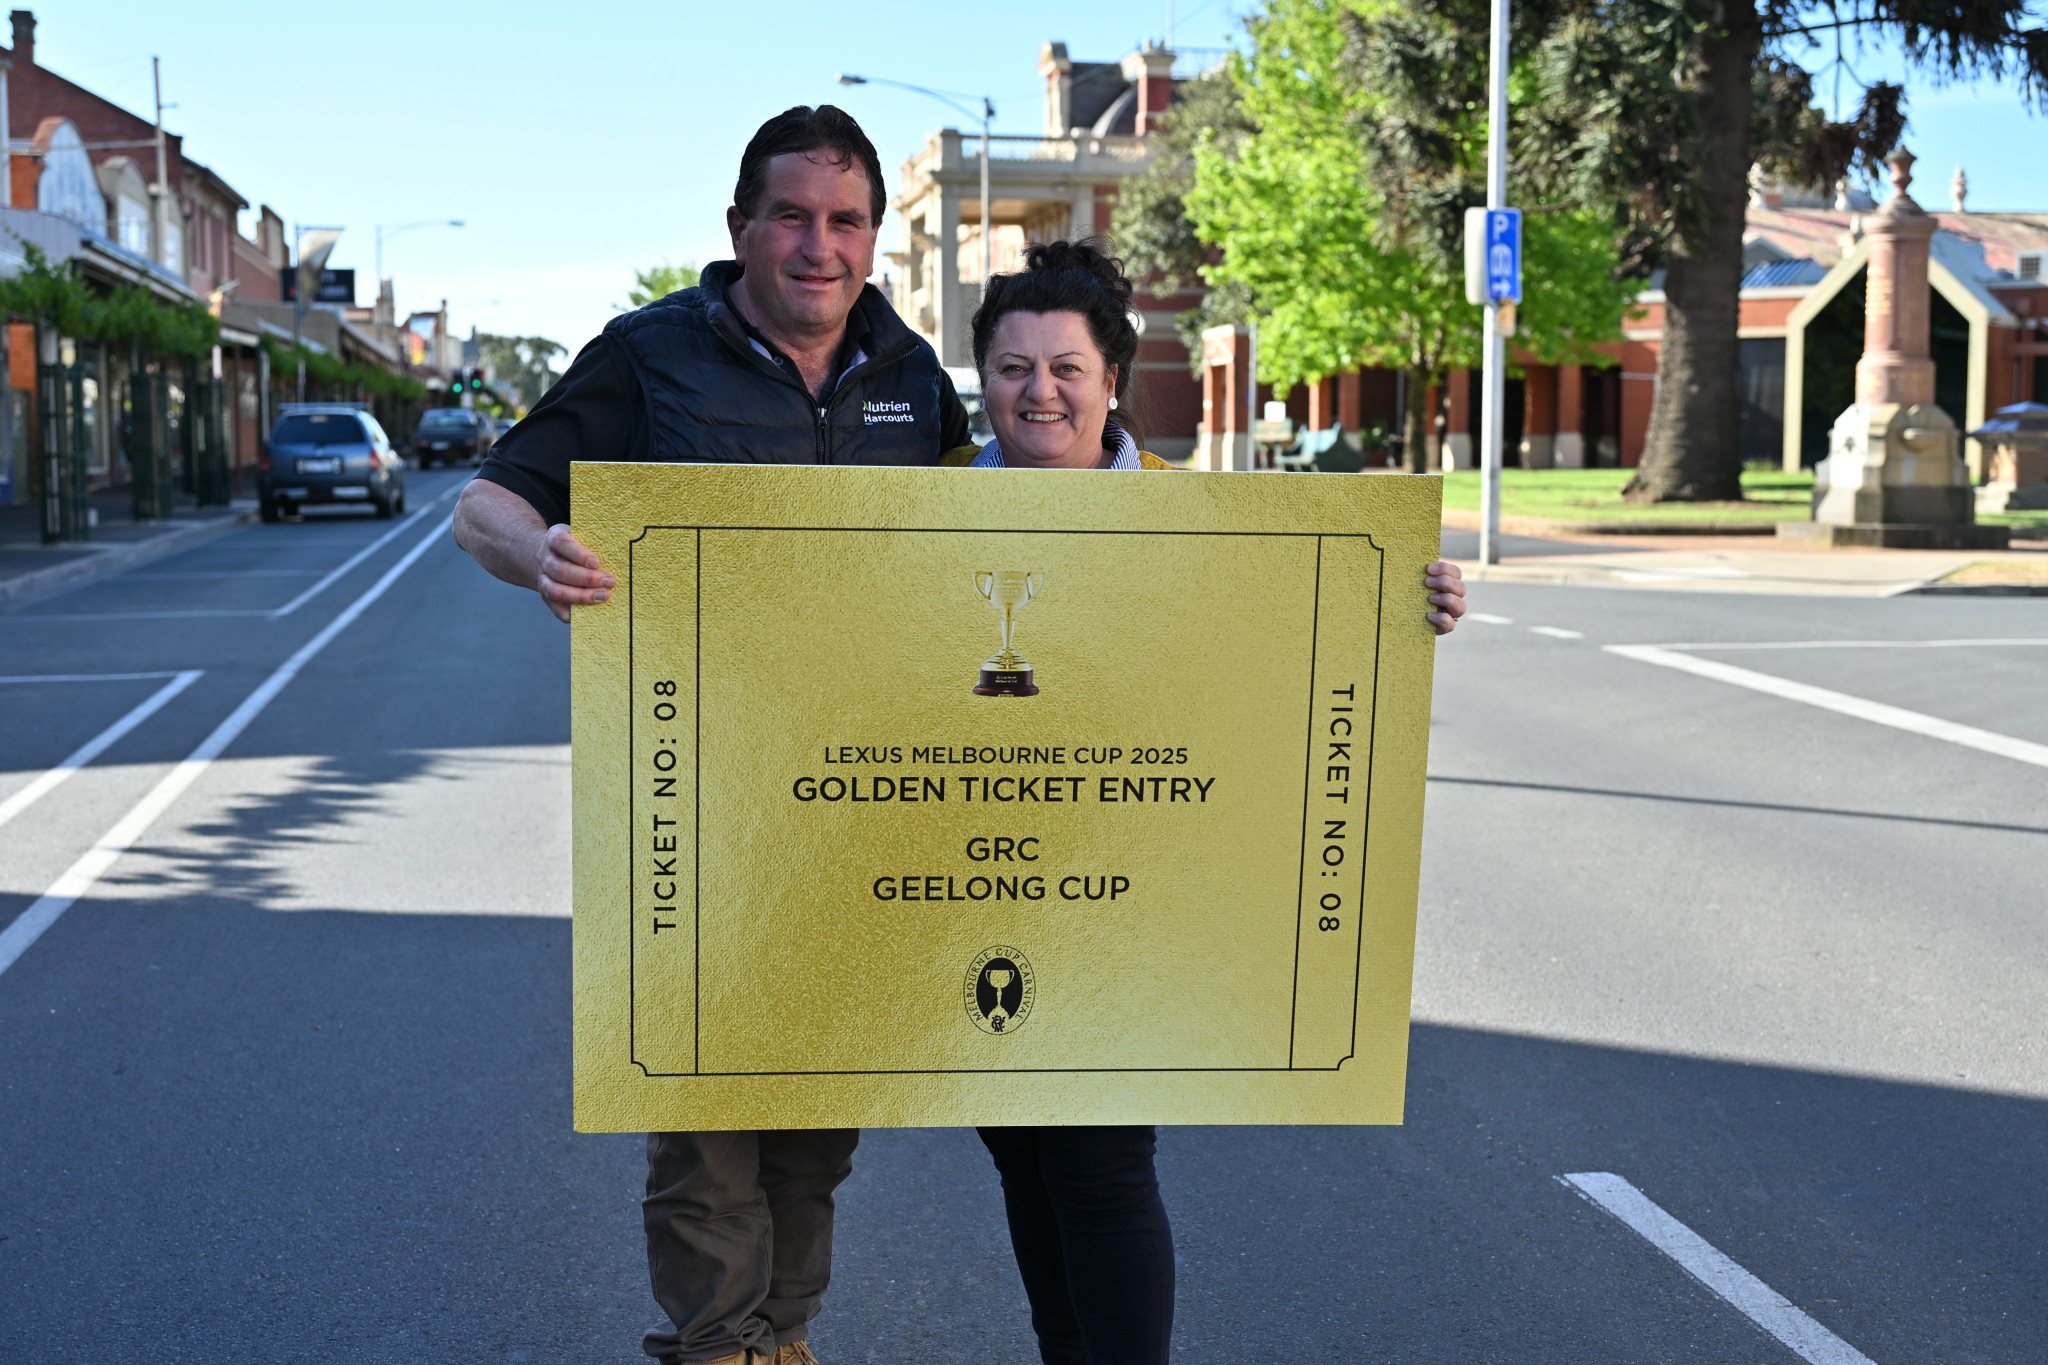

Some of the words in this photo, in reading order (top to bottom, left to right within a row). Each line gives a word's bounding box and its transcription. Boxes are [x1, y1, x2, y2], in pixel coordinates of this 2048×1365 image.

[1492, 213, 1510, 243] P
[862, 400, 911, 412] Nutrien
[863, 413, 915, 423] Harcourts
[653, 680, 677, 721] 08
[825, 746, 903, 764] LEXUS
[912, 747, 1066, 764] MELBOURNE
[1073, 747, 1123, 764] CUP
[1130, 747, 1188, 765] 2025
[1326, 683, 1355, 804] TICKET
[653, 738, 677, 797] NO:
[793, 777, 946, 802] GOLDEN
[959, 777, 1086, 802] TICKET
[1099, 777, 1216, 802] ENTRY
[966, 837, 1040, 862] GRC
[1321, 820, 1347, 877] NO:
[653, 814, 677, 935] TICKET
[873, 876, 1046, 901] GEELONG
[1058, 876, 1130, 901] CUP
[1318, 892, 1342, 932] 08
[966, 952, 992, 1022] MELBOURNE
[995, 948, 1020, 960] CUP
[1016, 963, 1033, 1020] CARNIVAL
